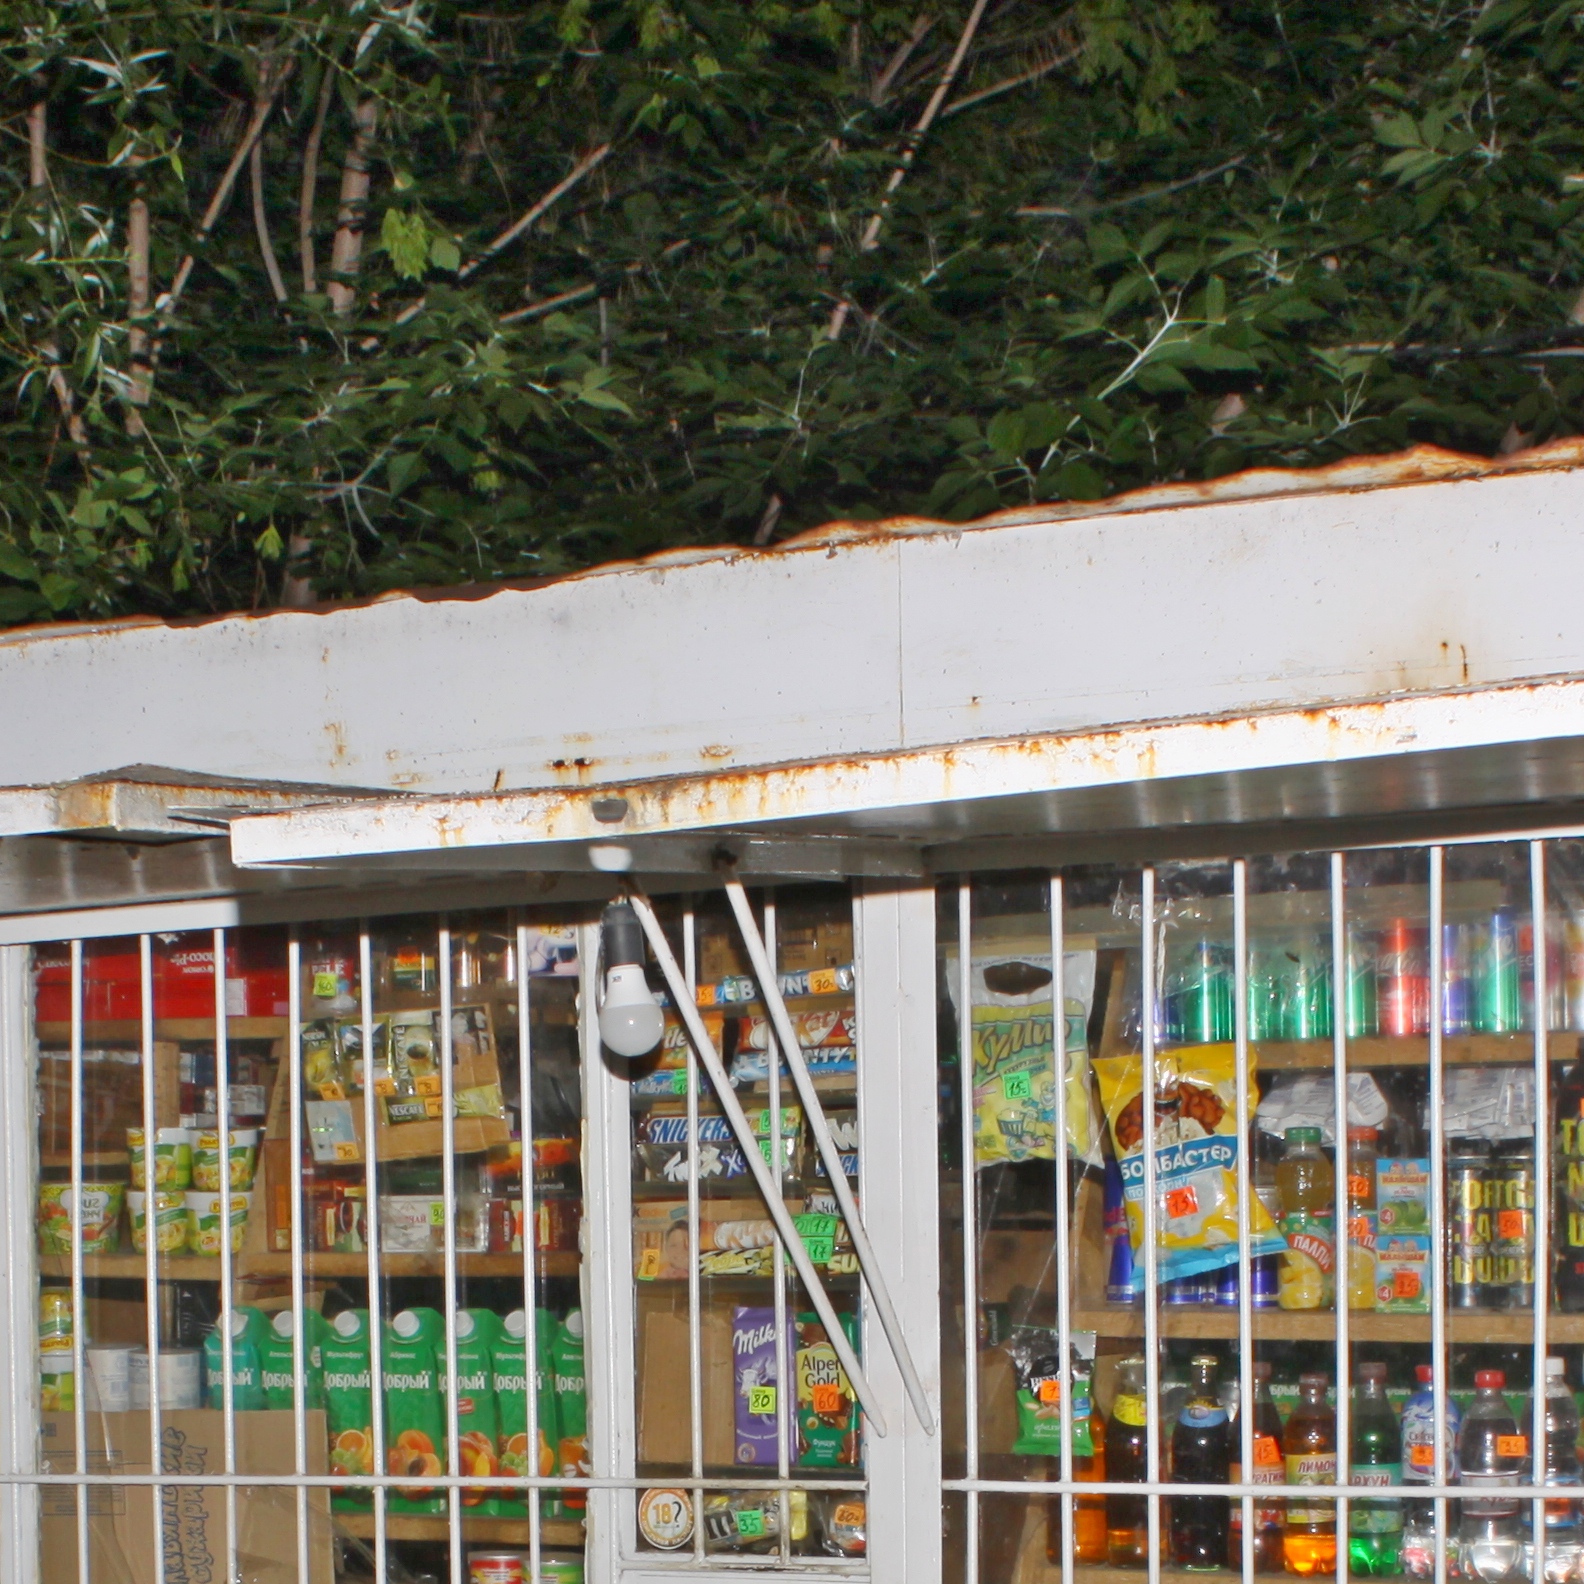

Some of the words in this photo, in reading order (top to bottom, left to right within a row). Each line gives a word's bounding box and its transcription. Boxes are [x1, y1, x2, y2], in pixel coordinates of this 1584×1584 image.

[733, 1323, 777, 1355] Milk
[555, 1372, 584, 1393] Добр
[1297, 1458, 1337, 1475] ЛИМОН
[1348, 1473, 1390, 1487] АРХУН
